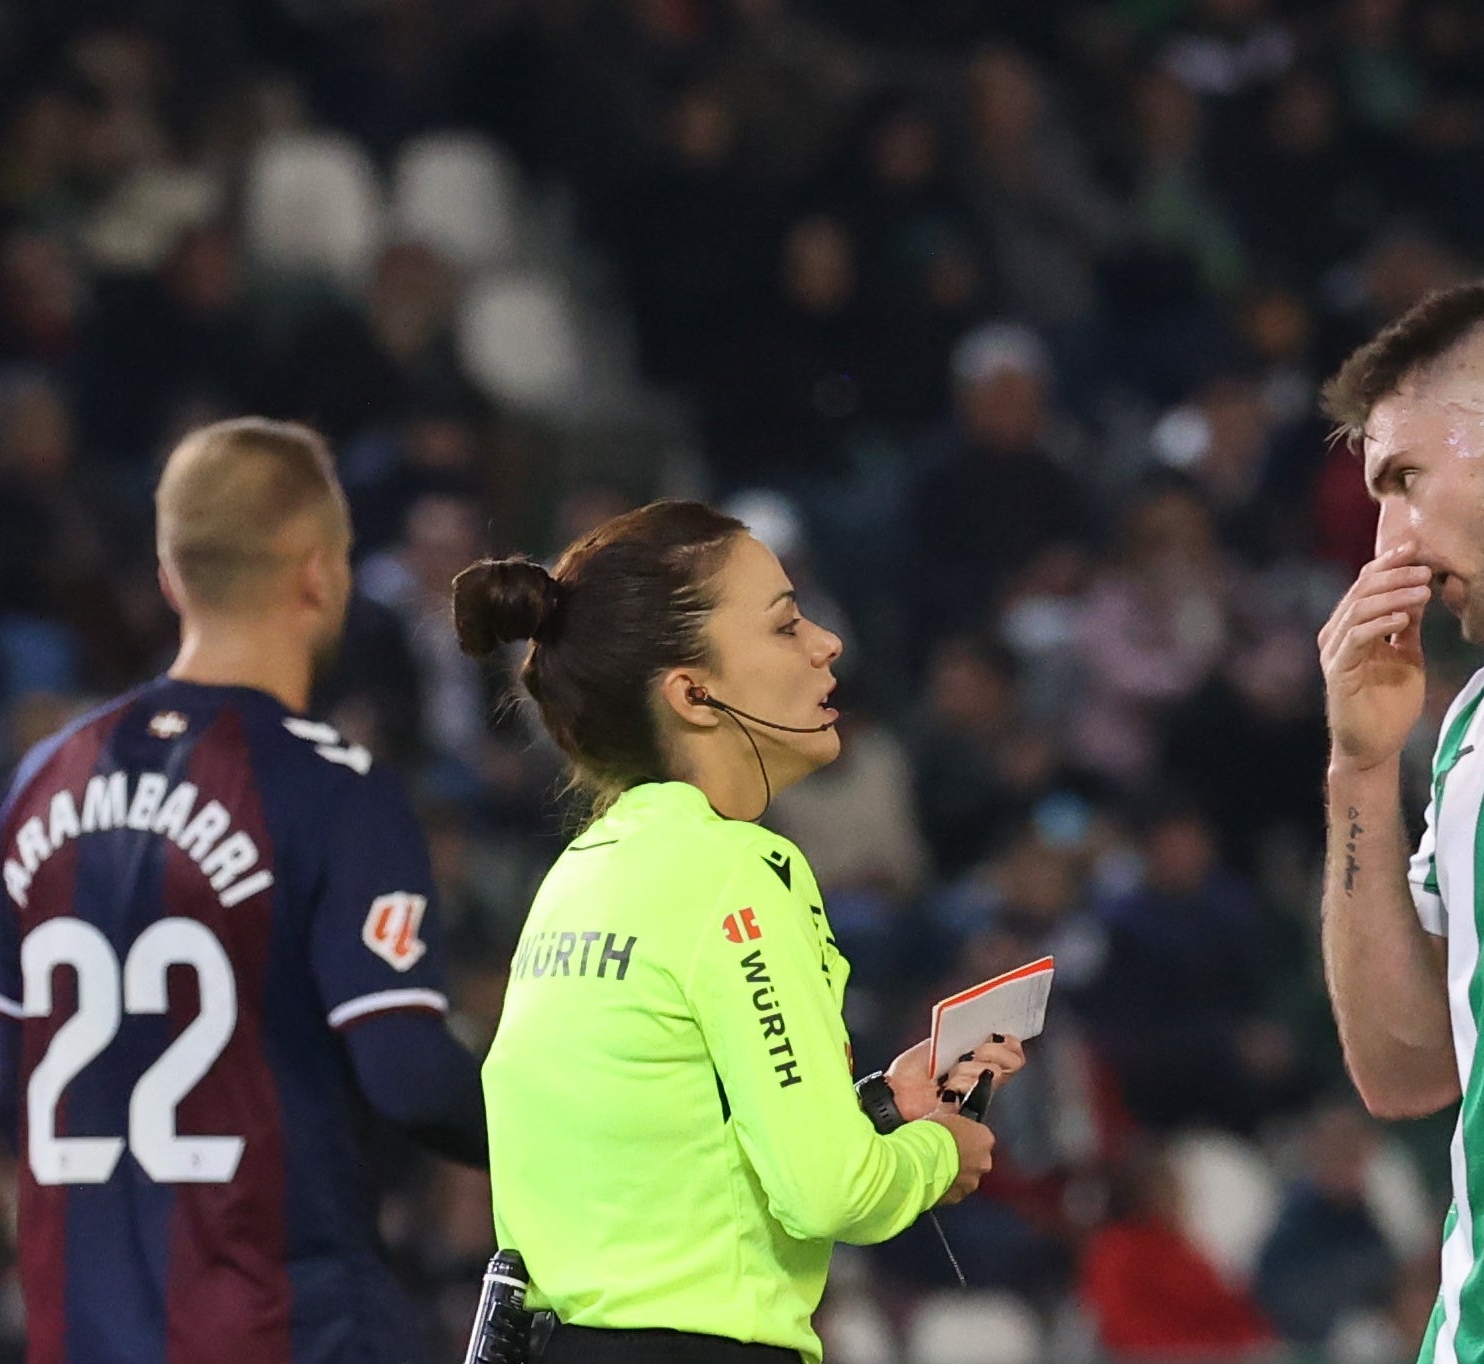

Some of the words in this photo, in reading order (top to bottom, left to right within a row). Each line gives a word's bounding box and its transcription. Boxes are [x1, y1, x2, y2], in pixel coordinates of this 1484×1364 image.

[2, 770, 275, 909] ARAMBARRI
[20, 916, 246, 1186] 22
[740, 949, 803, 1089] WÜRTH
